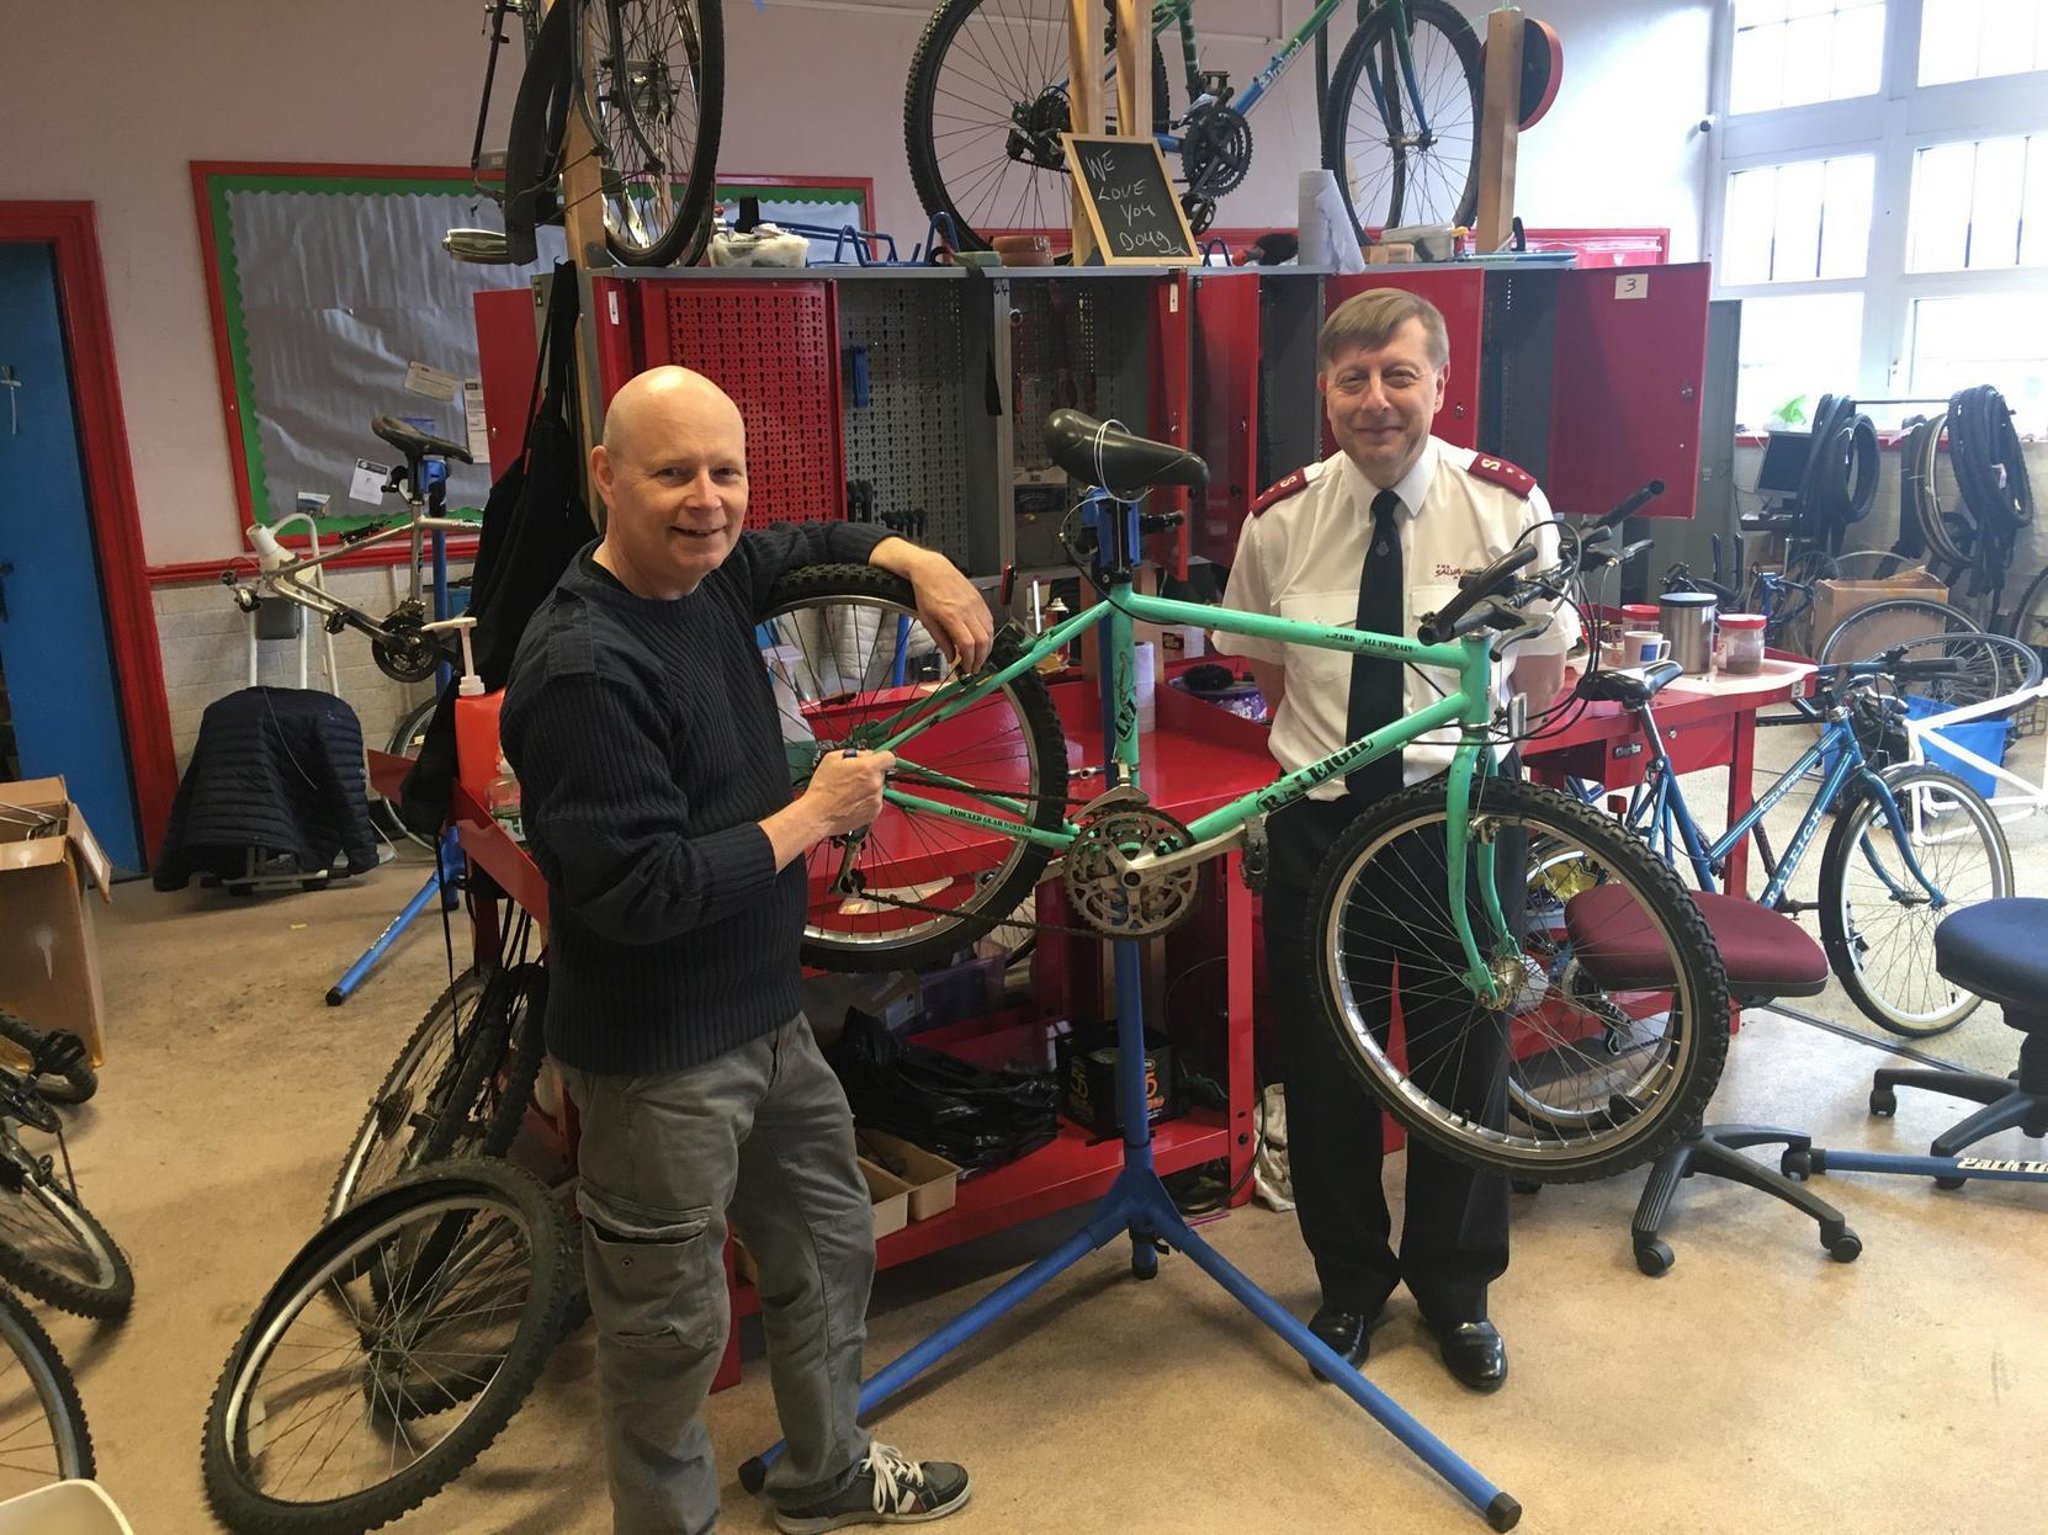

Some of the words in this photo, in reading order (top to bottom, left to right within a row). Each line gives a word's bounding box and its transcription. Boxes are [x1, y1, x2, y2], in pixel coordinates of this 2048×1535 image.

[1085, 150, 1116, 182] WE
[1098, 178, 1149, 200] LOVE
[1624, 278, 1637, 293] 3
[1481, 458, 1501, 471] S
[1766, 806, 1823, 904] RALEIGH
[1956, 1157, 2019, 1172] Park
